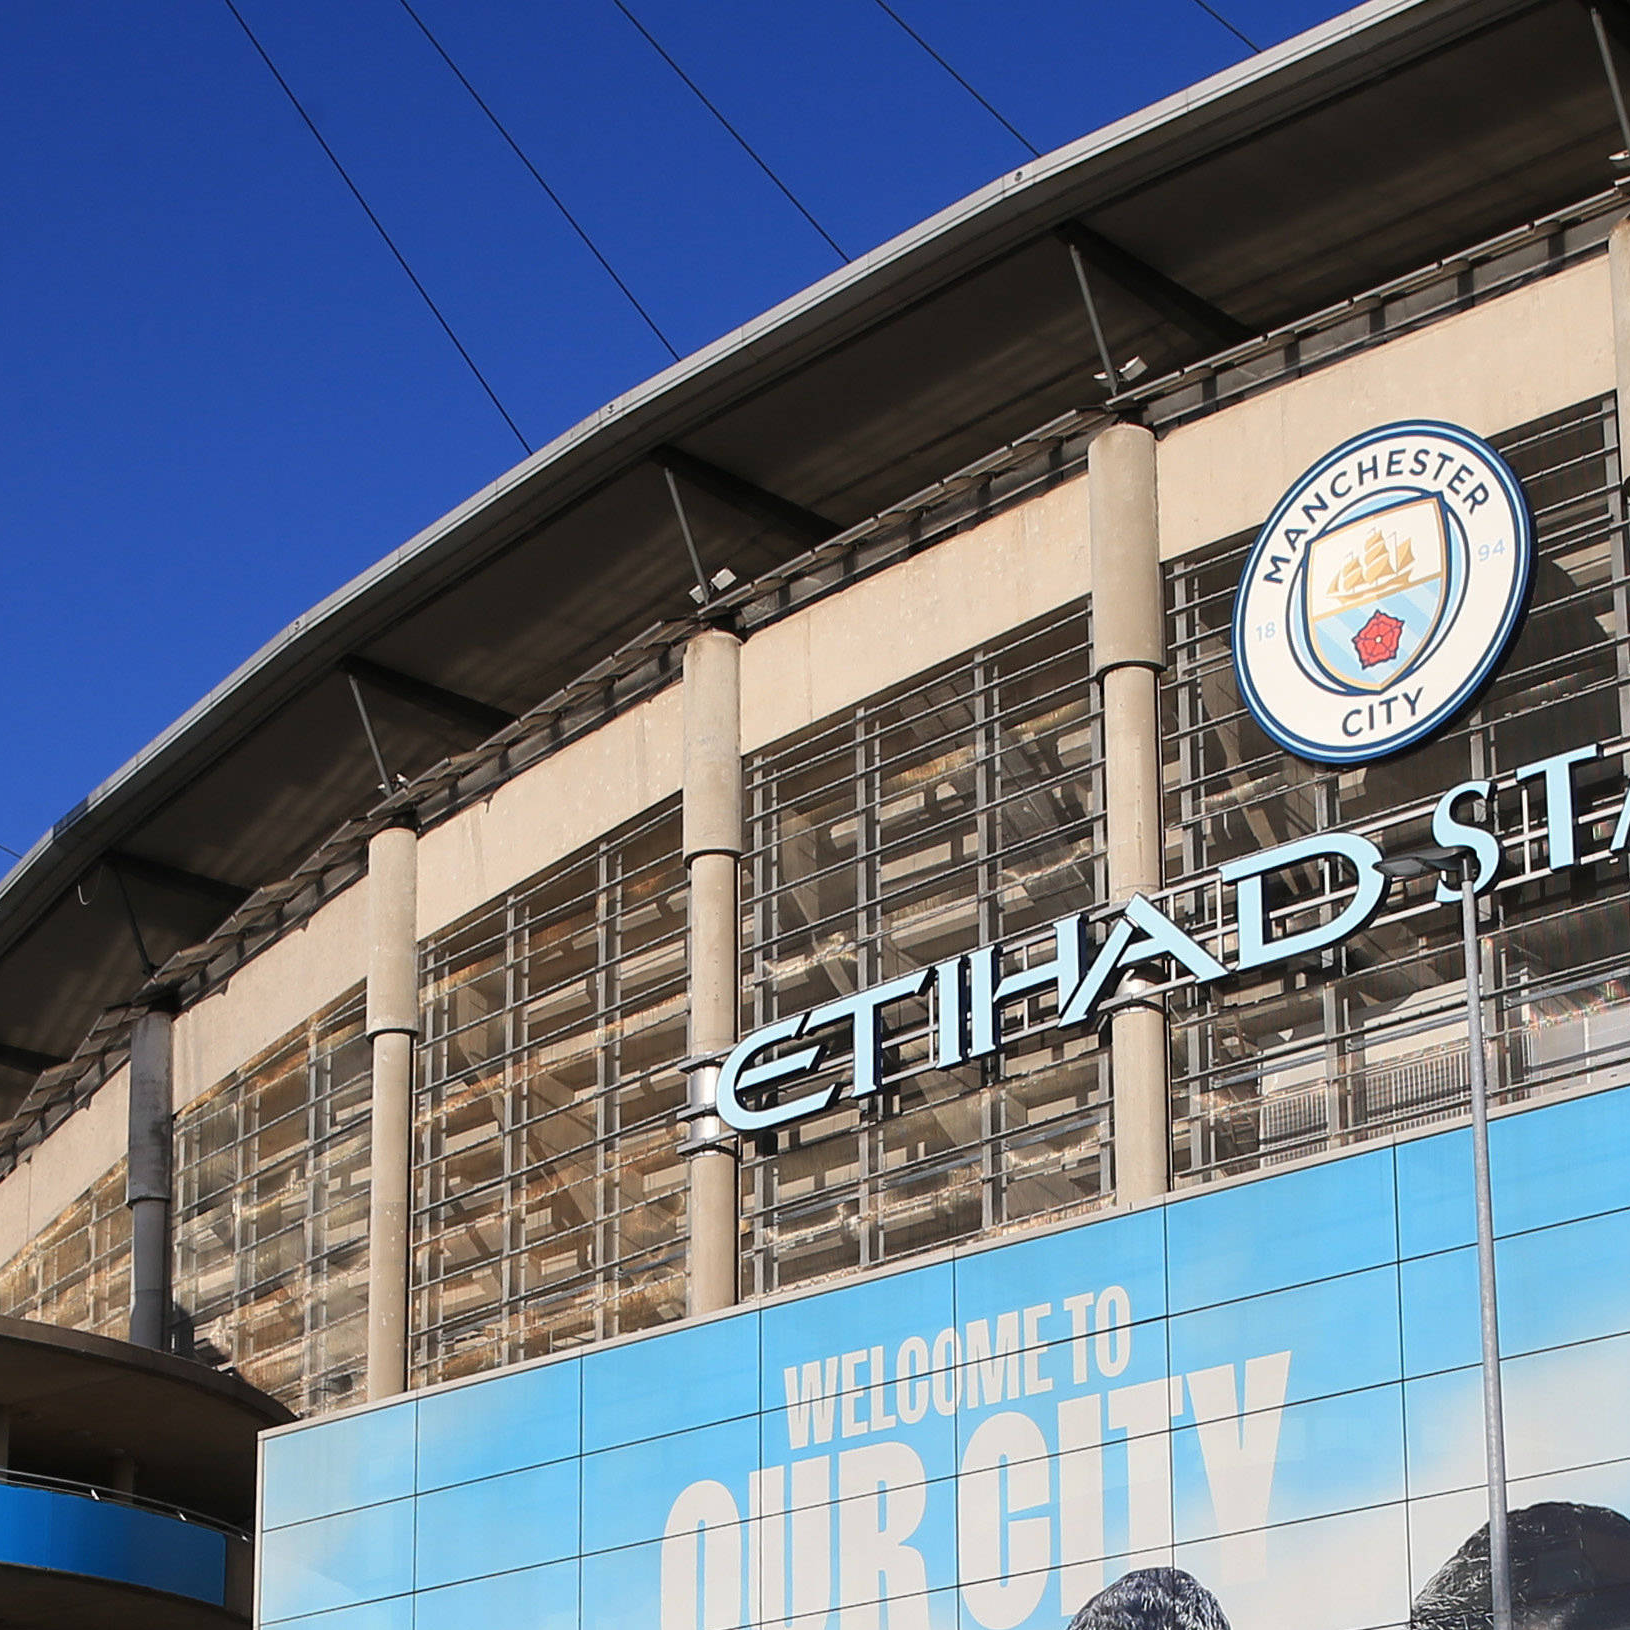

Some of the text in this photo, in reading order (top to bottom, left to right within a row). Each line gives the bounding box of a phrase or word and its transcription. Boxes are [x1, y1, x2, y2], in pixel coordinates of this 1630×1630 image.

[1255, 538, 1506, 643] 18 94
[1263, 448, 1490, 584] MANCHESTER
[1342, 686, 1424, 737] CITY
[714, 830, 1387, 1135] ETIHAD
[784, 1284, 1132, 1450] WELCOME TO
[960, 1350, 1293, 1630] CITY
